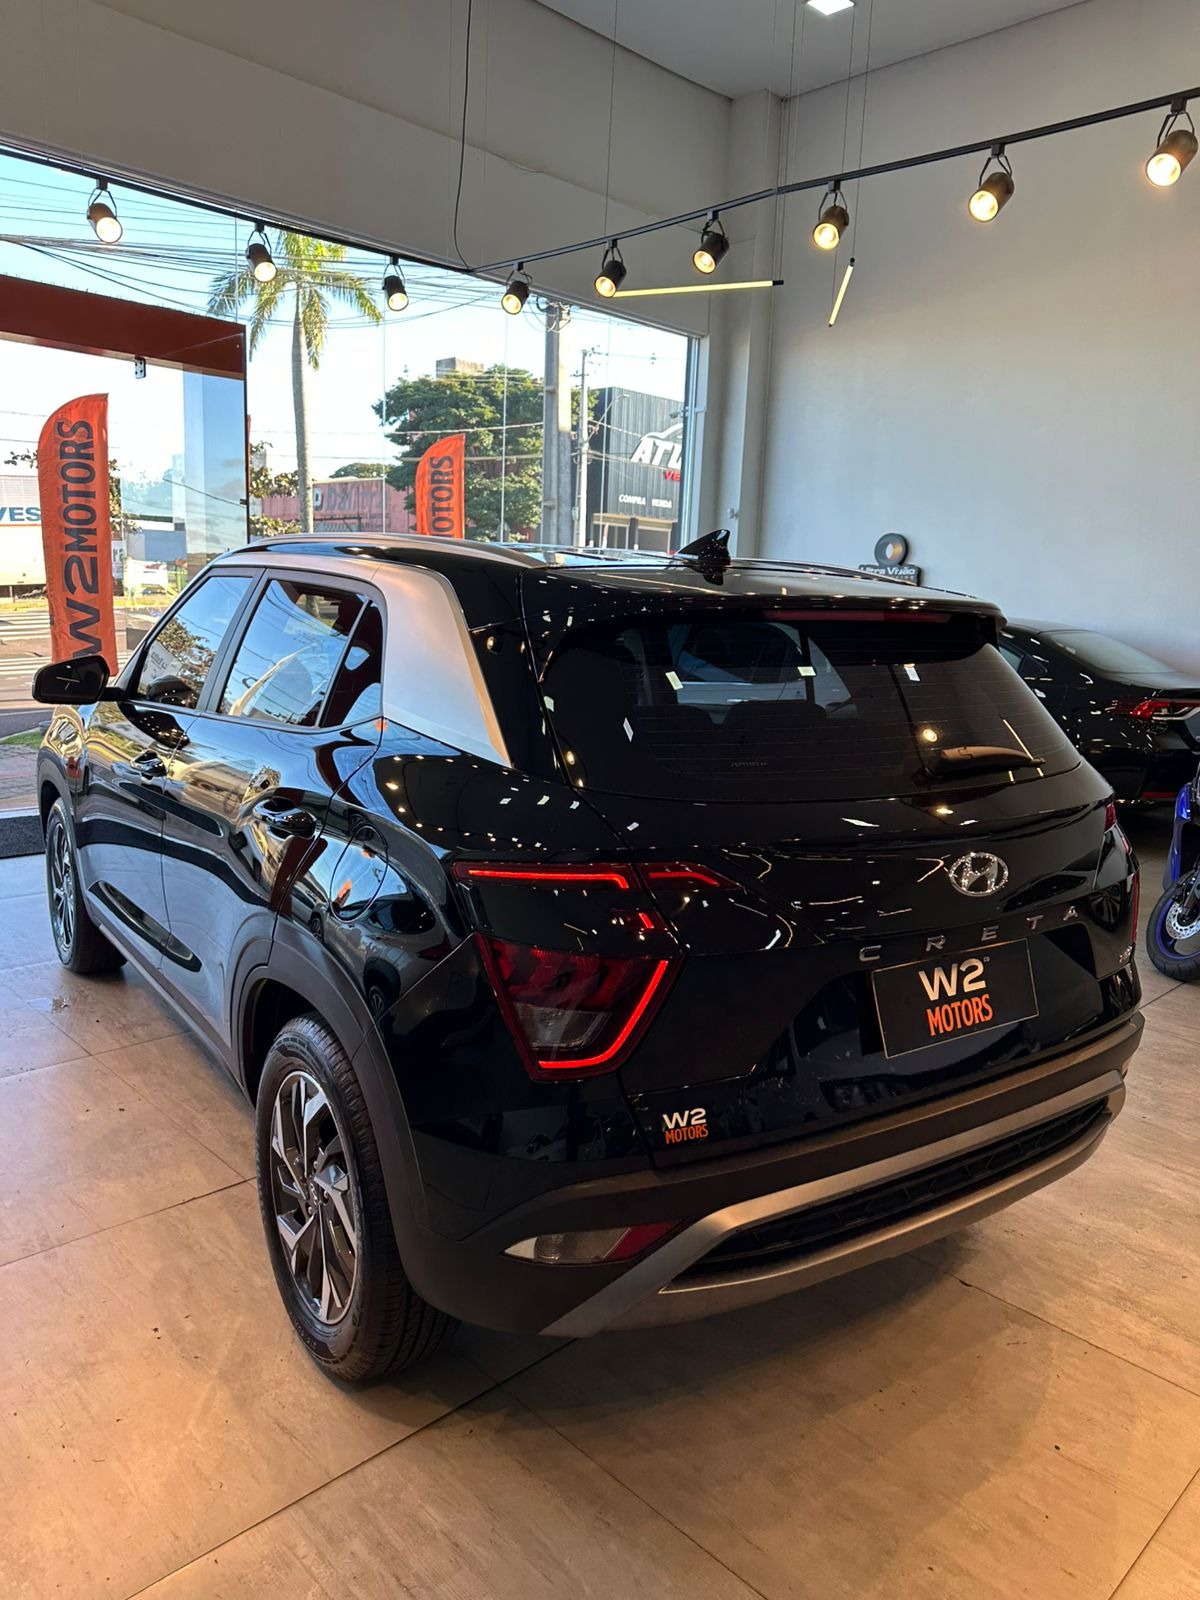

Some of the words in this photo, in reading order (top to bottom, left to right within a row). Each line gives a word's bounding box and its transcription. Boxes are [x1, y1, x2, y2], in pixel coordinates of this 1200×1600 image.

[430, 455, 455, 537] OTORS
[618, 494, 646, 506] COMPRA
[651, 498, 673, 509] VENDA
[859, 905, 1079, 962] CRETA
[918, 958, 987, 1001] W2
[926, 993, 993, 1036] MOTORS
[662, 1107, 707, 1129] W2
[665, 1123, 709, 1145] MOTORS
